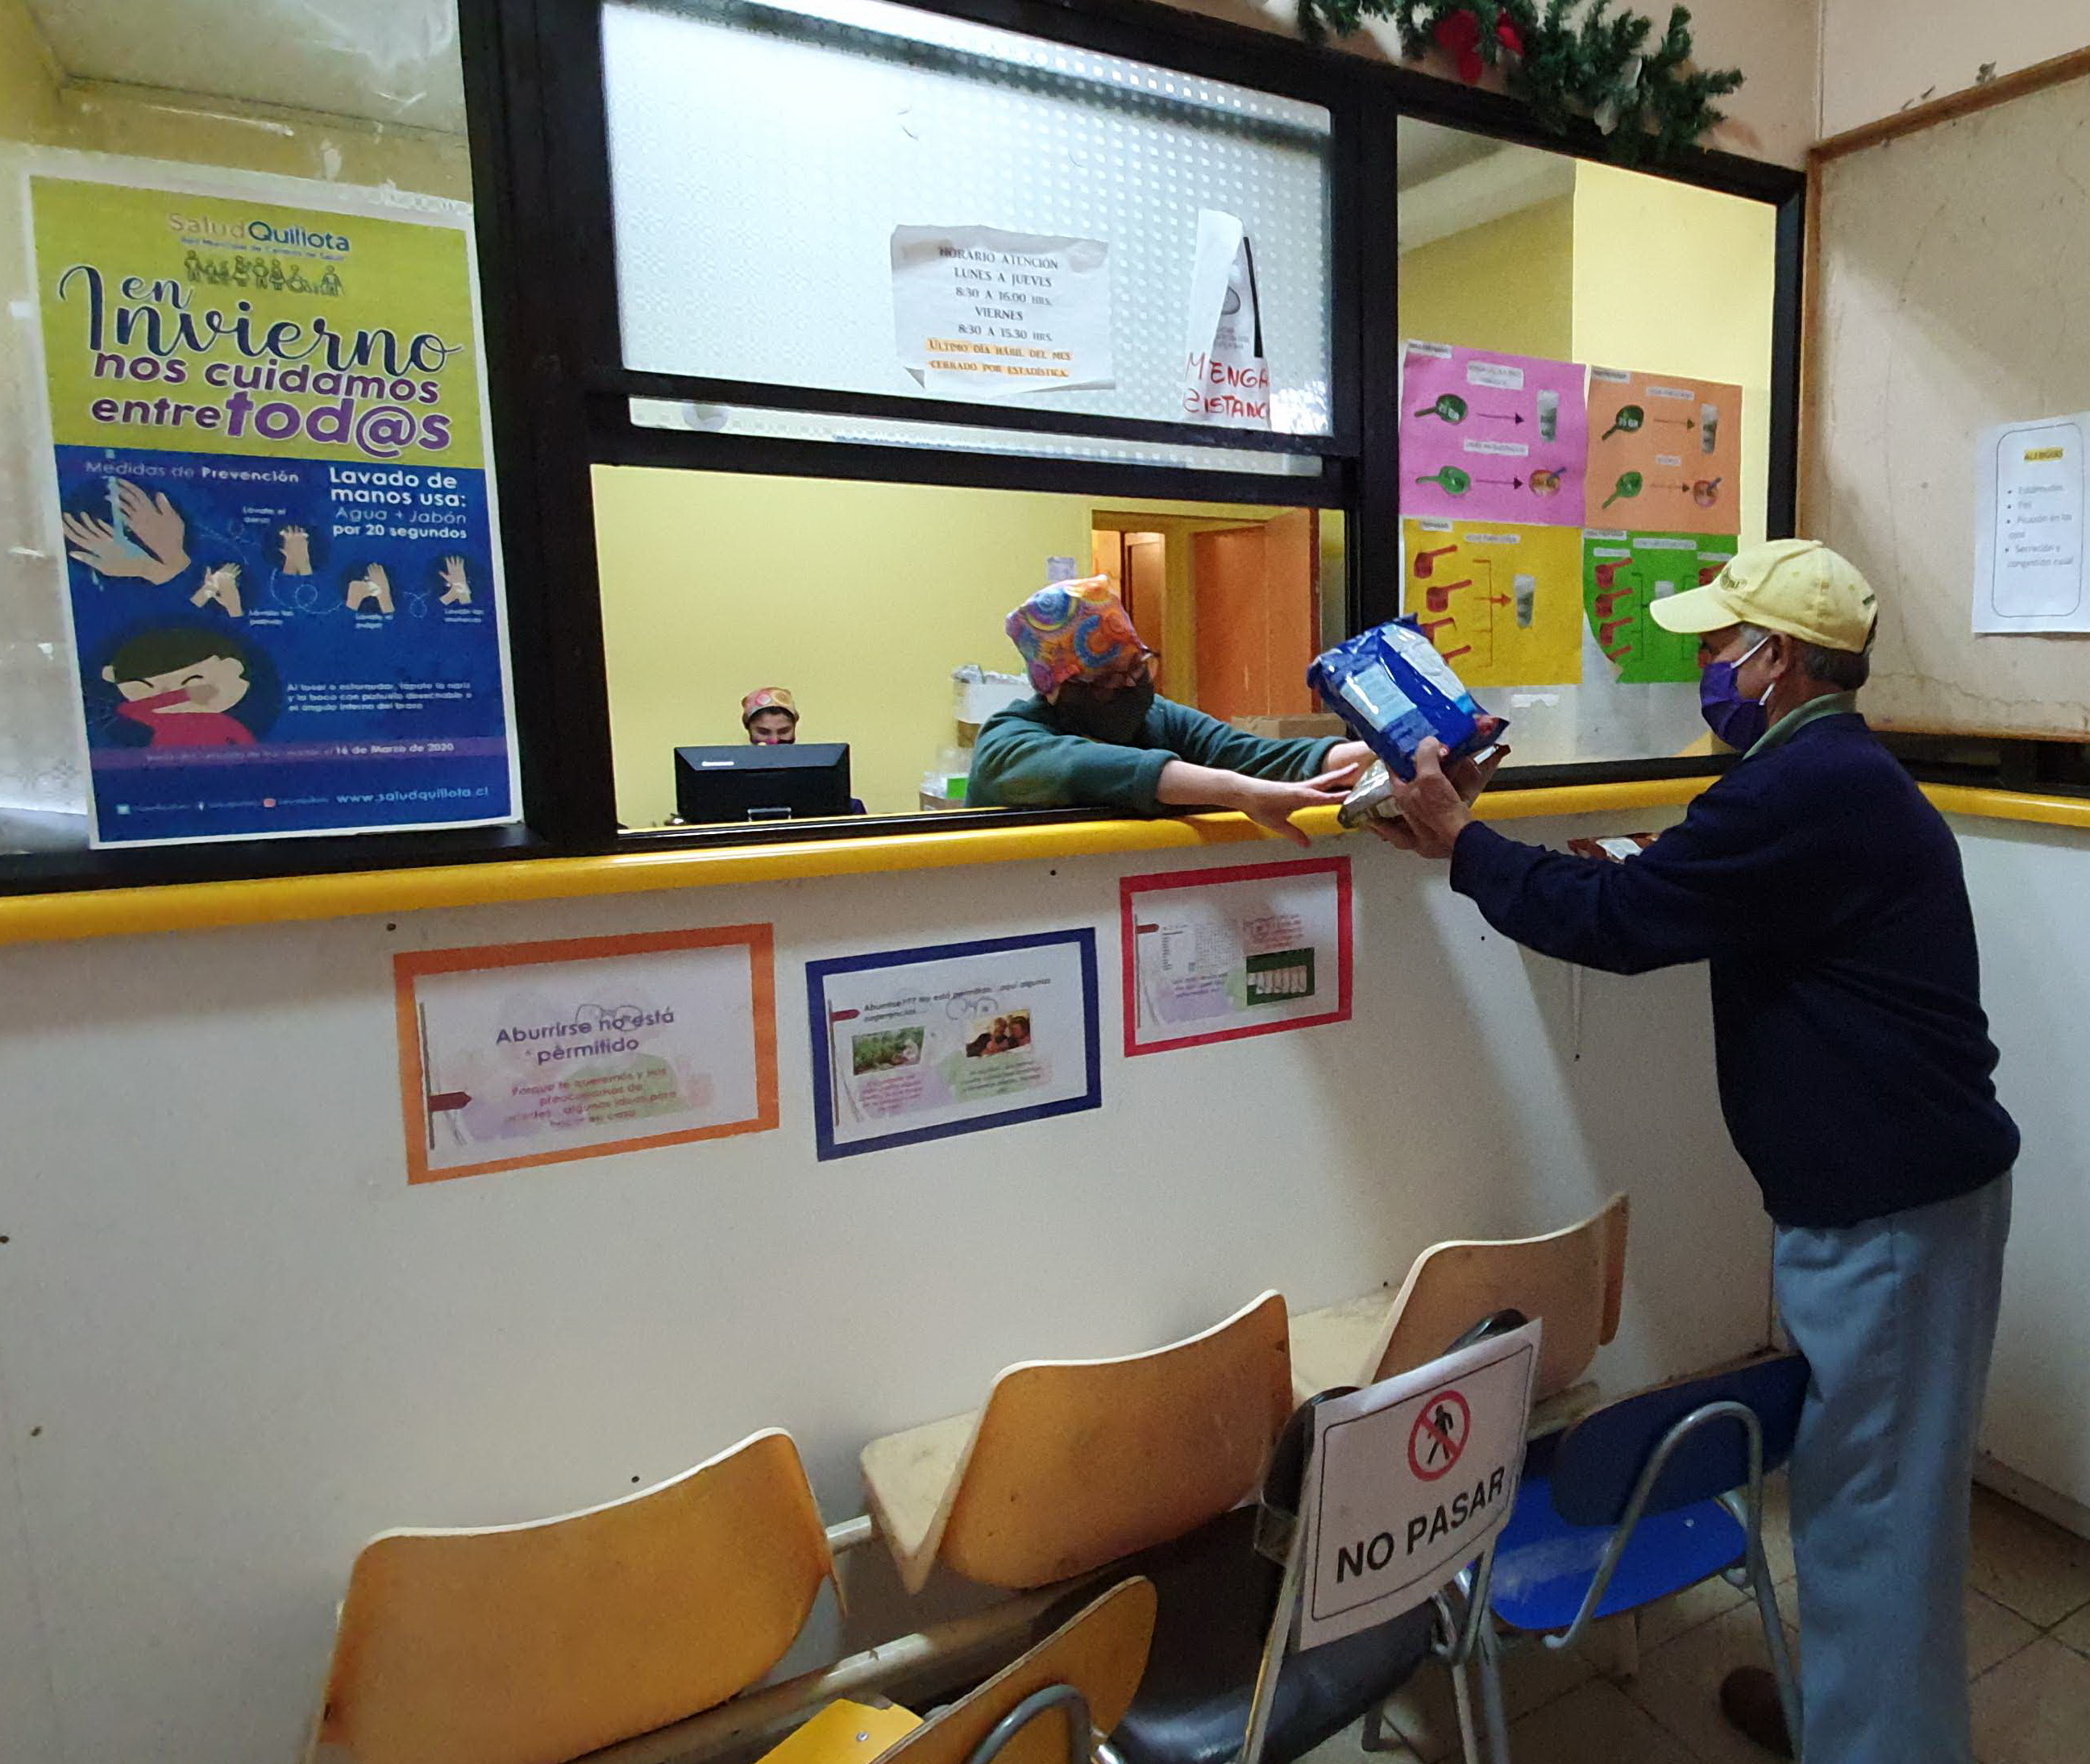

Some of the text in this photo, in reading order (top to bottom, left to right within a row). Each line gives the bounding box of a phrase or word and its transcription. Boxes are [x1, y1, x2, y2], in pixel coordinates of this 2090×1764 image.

[938, 246, 995, 263] HORARIO
[954, 267, 1053, 287] LUNES A JUEVES
[121, 276, 193, 309] en
[985, 290, 993, 300] A
[59, 265, 463, 376] Invierno
[975, 306, 1024, 321] VIERNES
[987, 327, 995, 336] A
[93, 349, 440, 404] nos cuidamos
[983, 364, 1002, 373] POR
[85, 462, 299, 484] Medidas de Prevención
[330, 467, 457, 489] Lavado de
[330, 488, 467, 508] manos usa:
[335, 507, 387, 522] Agua
[409, 510, 467, 524] Jabón
[333, 525, 467, 539] por 20 segundos
[351, 745, 368, 754] de
[370, 744, 406, 753] Marzo
[409, 743, 425, 753] de
[496, 1007, 675, 1044] Aburrirse no está
[538, 1037, 639, 1065] permitido
[1336, 1466, 1505, 1583] NO PASAR
